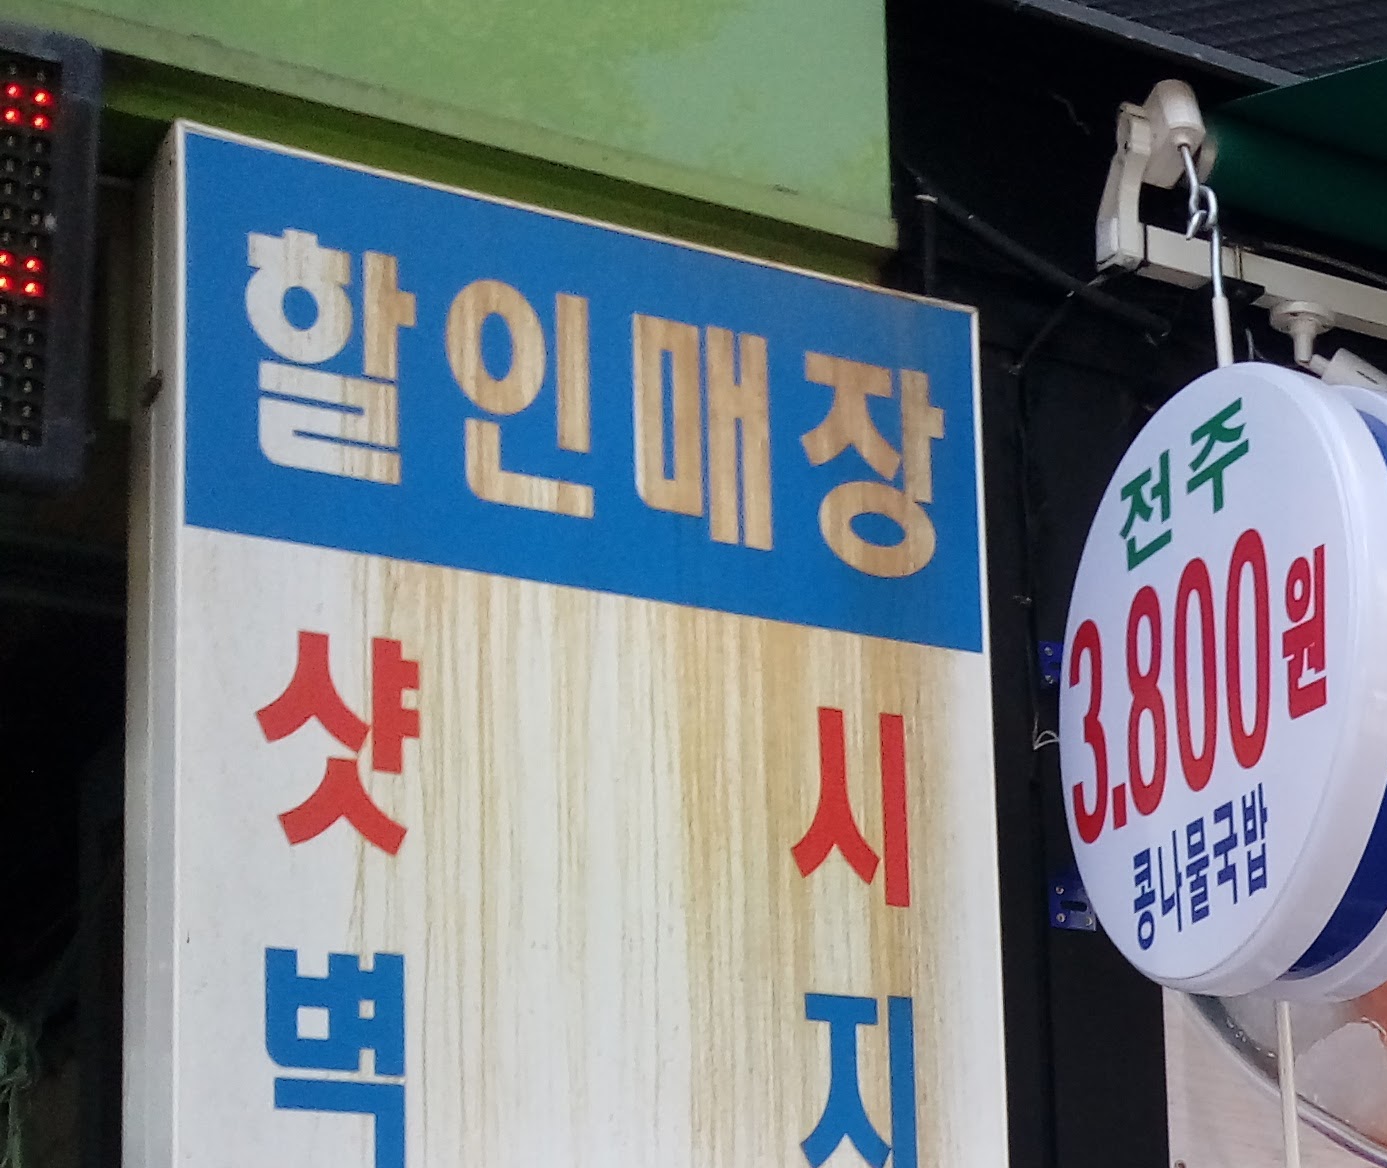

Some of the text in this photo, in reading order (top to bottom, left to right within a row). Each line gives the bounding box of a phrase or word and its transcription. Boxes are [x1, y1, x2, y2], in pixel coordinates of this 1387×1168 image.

[246, 228, 945, 578] 할인매장
[1117, 397, 1250, 571] 전주
[1067, 528, 1327, 844] 3.800원
[1132, 783, 1269, 951] 콩나물국밥
